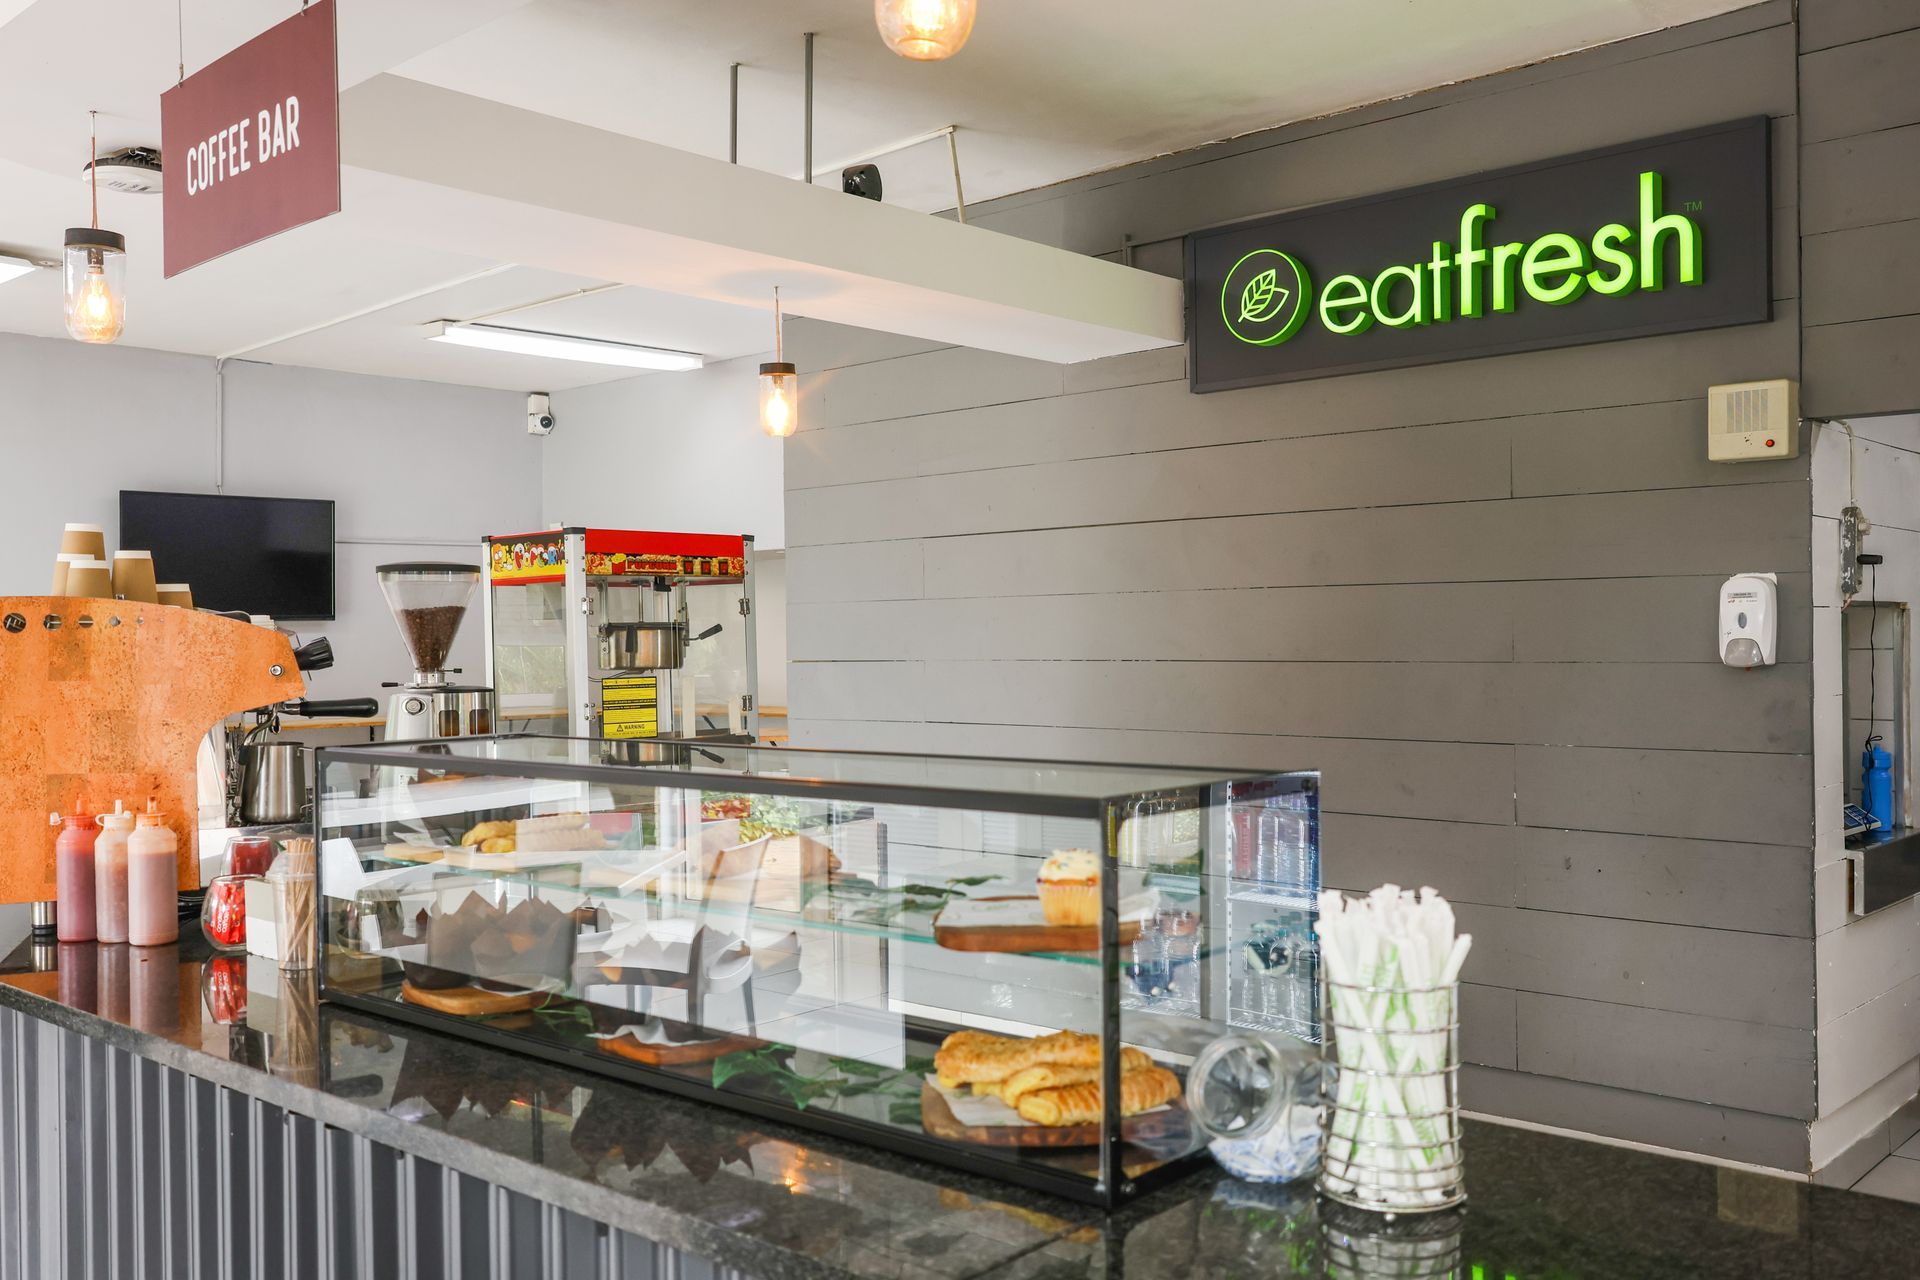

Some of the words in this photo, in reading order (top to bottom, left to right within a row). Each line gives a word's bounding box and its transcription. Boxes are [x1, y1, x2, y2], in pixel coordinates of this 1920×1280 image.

[187, 118, 251, 196] COFFEE
[258, 96, 300, 164] BAR
[1319, 171, 1703, 334] eatfresh
[1684, 201, 1703, 212] TM
